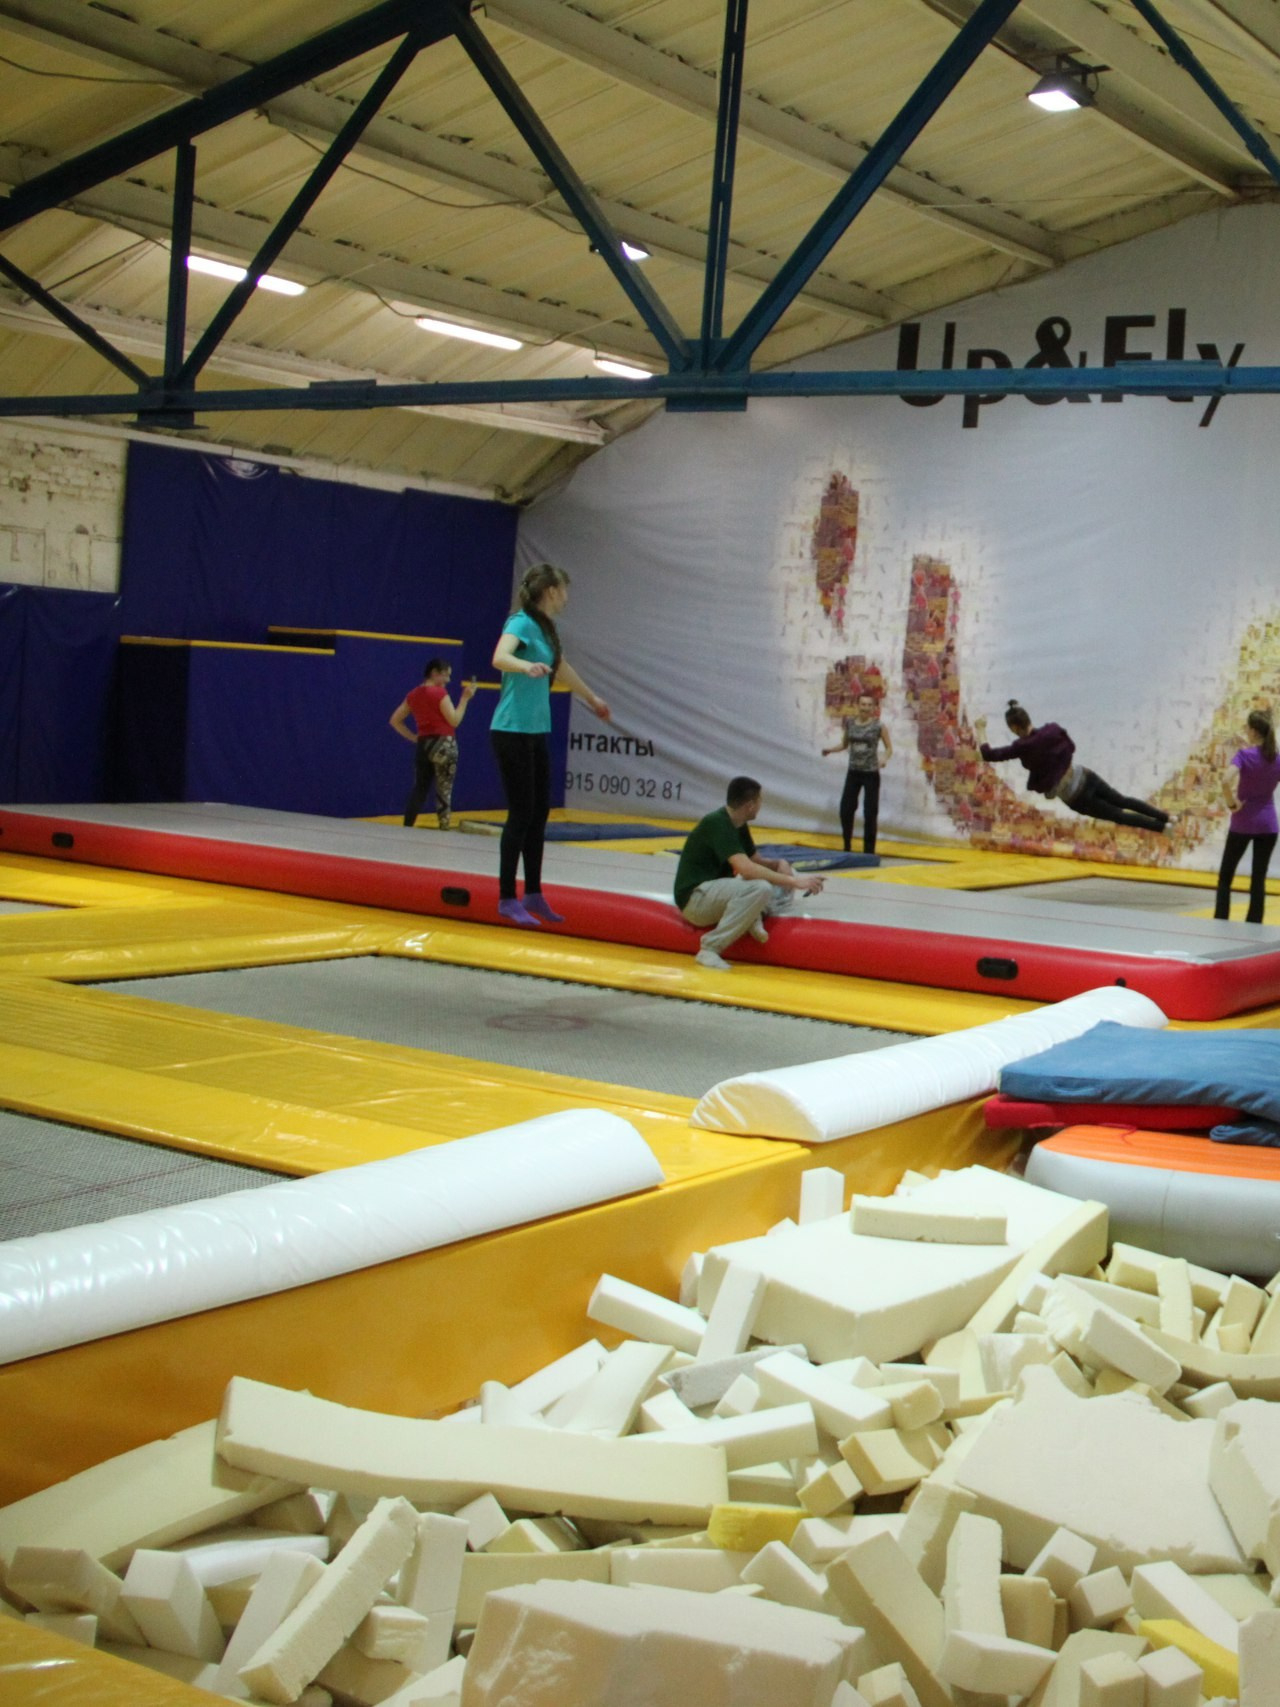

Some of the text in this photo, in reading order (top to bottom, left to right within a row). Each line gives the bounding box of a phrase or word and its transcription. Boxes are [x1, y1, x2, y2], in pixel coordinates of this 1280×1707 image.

[897, 308, 1245, 428] Up&Fly
[565, 771, 682, 801] 915 090 32 81
